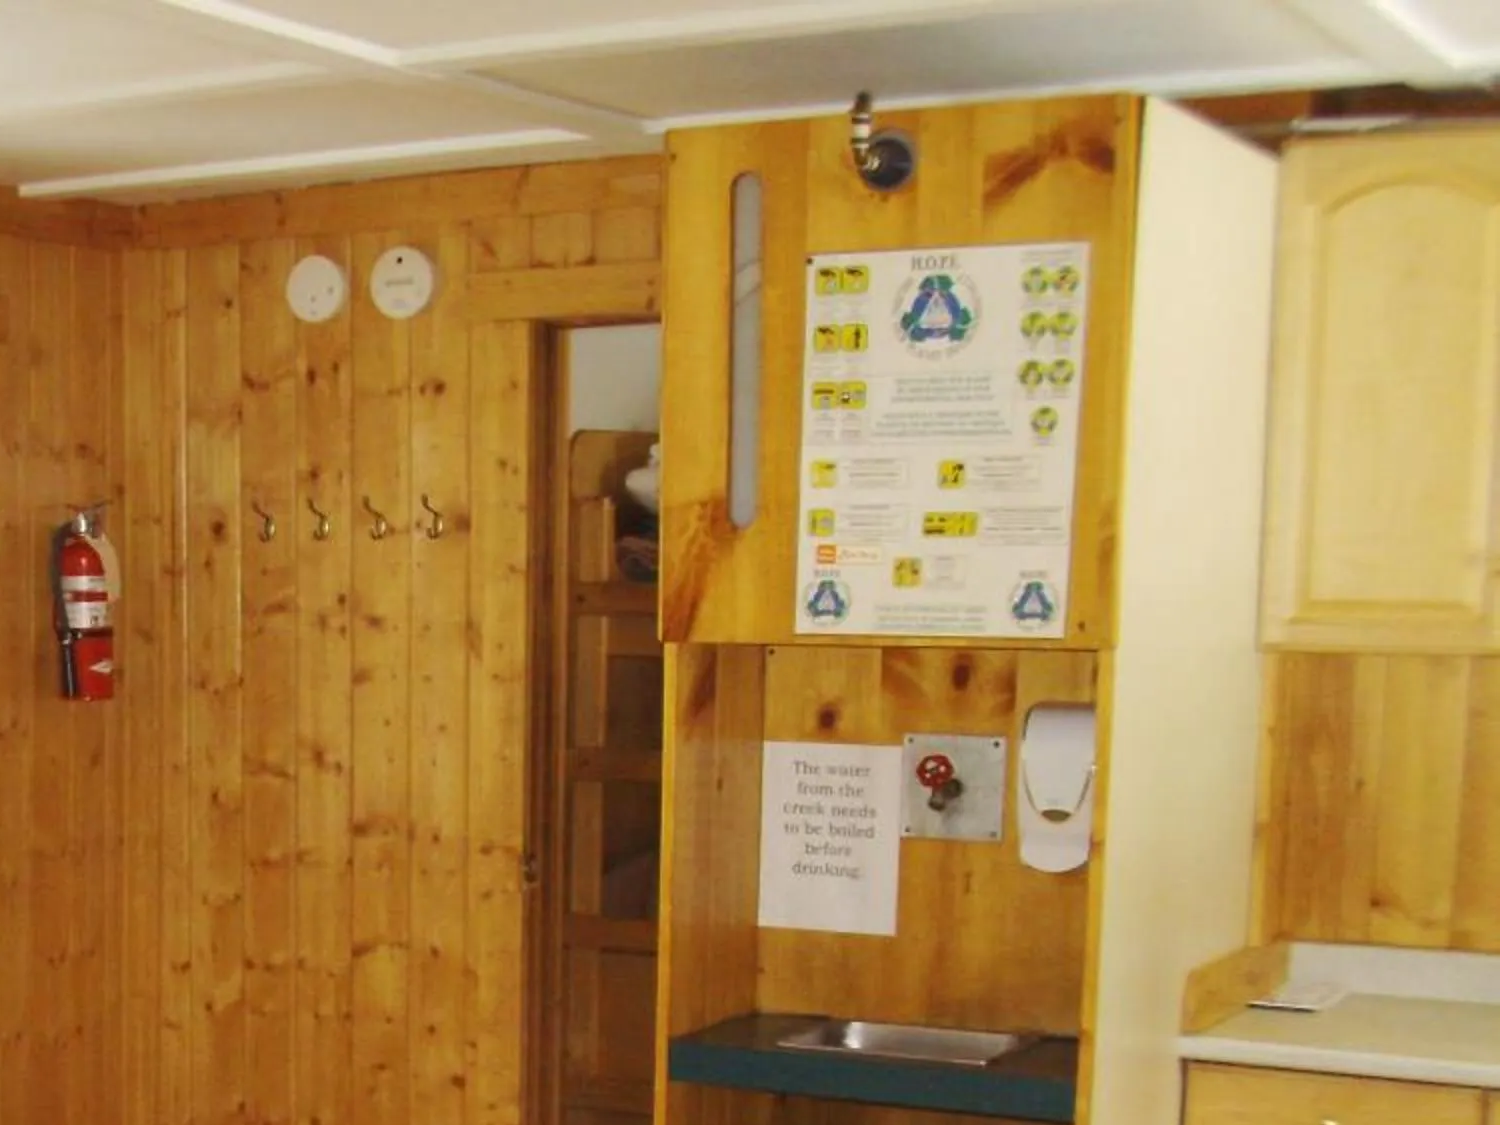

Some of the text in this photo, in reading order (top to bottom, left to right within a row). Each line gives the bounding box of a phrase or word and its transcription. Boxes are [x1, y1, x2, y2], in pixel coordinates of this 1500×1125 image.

[793, 760, 872, 778] The water
[797, 781, 864, 798] from the
[783, 800, 878, 819] creek needs
[784, 821, 876, 839] to be boiled
[804, 841, 853, 857] before
